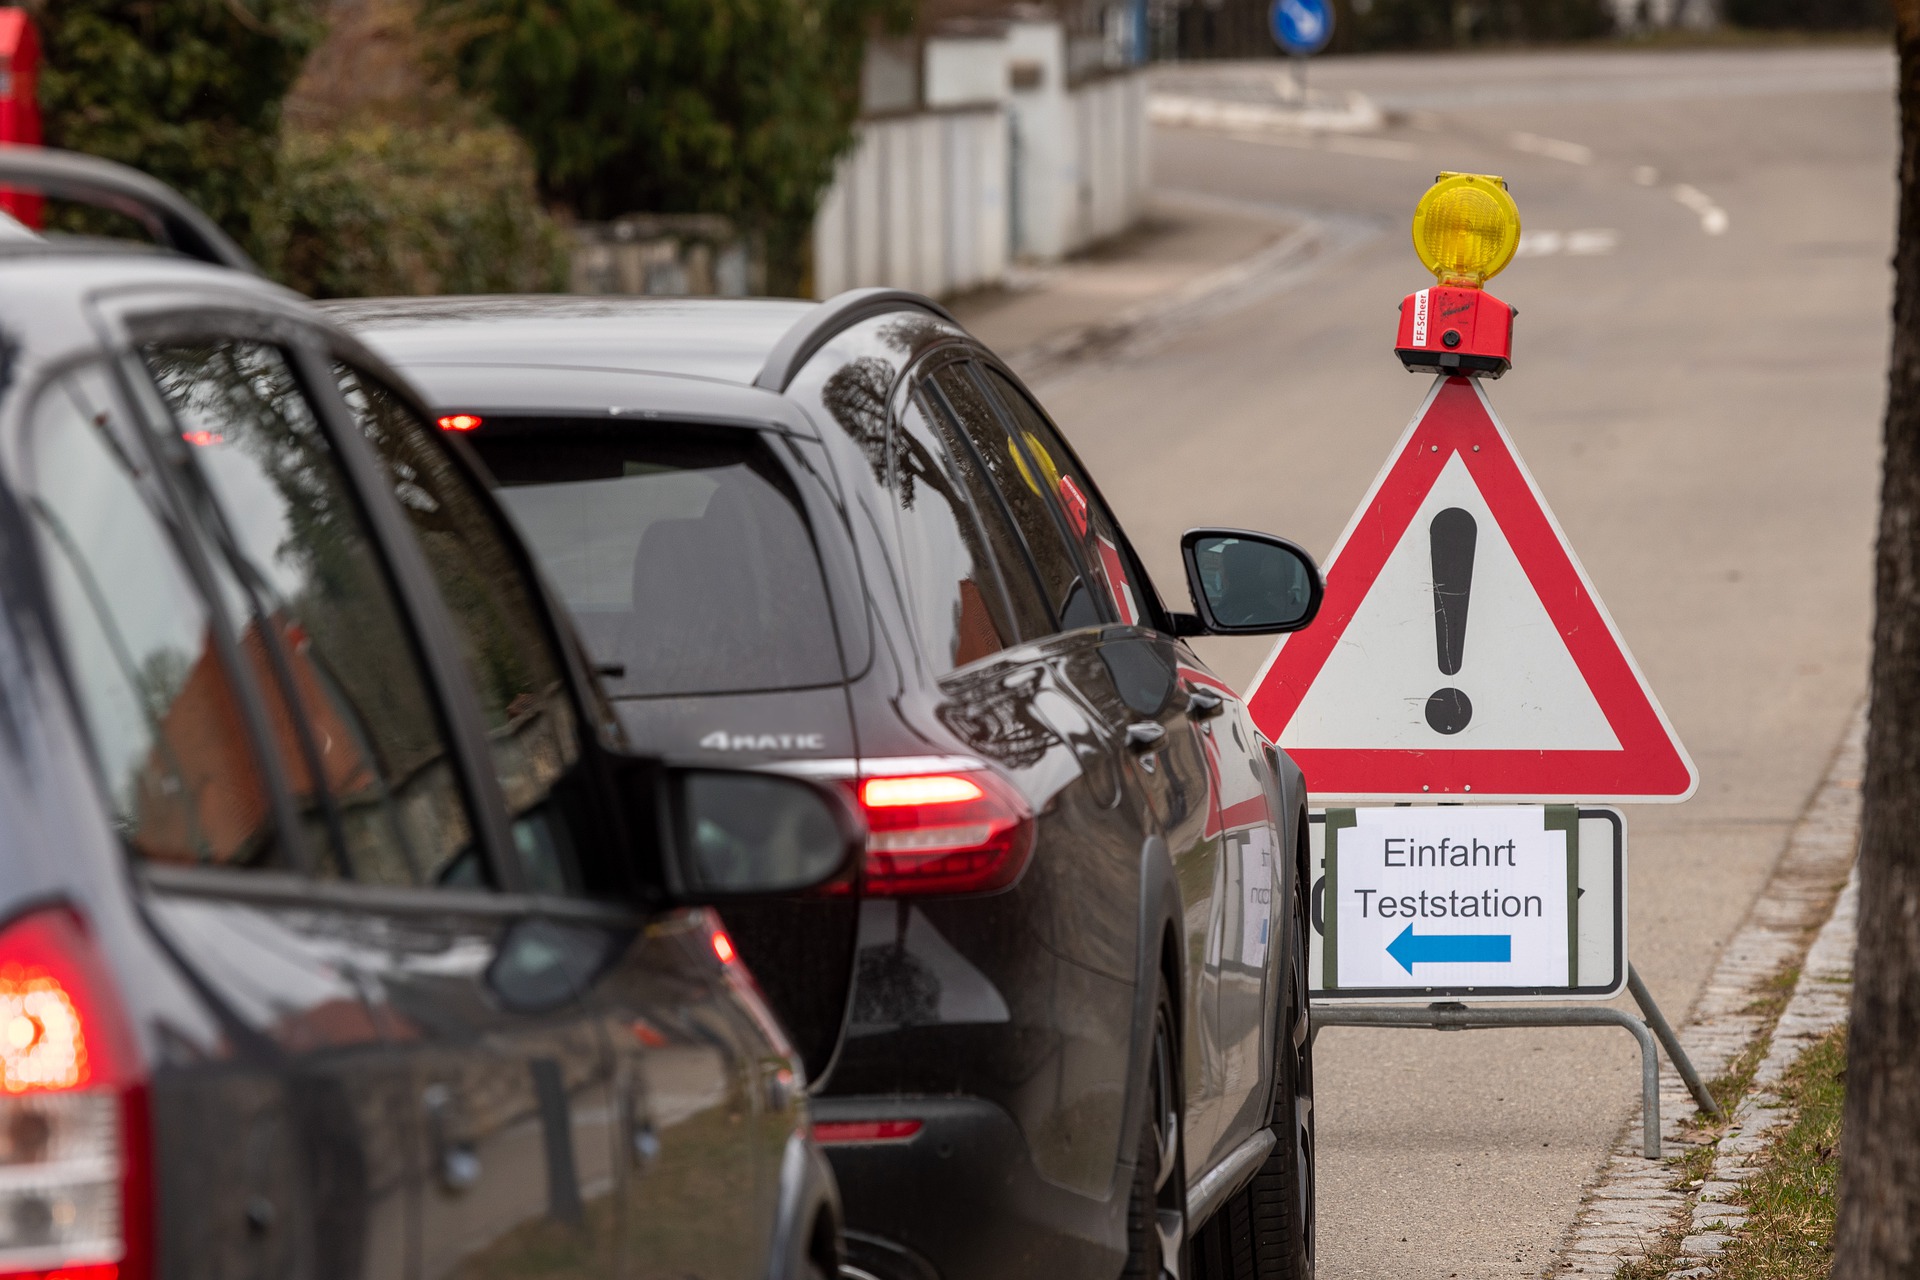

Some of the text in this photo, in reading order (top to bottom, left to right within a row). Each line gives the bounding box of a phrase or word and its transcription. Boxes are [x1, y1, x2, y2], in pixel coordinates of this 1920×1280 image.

[1415, 293, 1427, 341] FF-Scheer
[700, 730, 825, 751] 4MATIC
[1384, 837, 1516, 867] Einfahrt
[1354, 888, 1542, 918] Teststation
